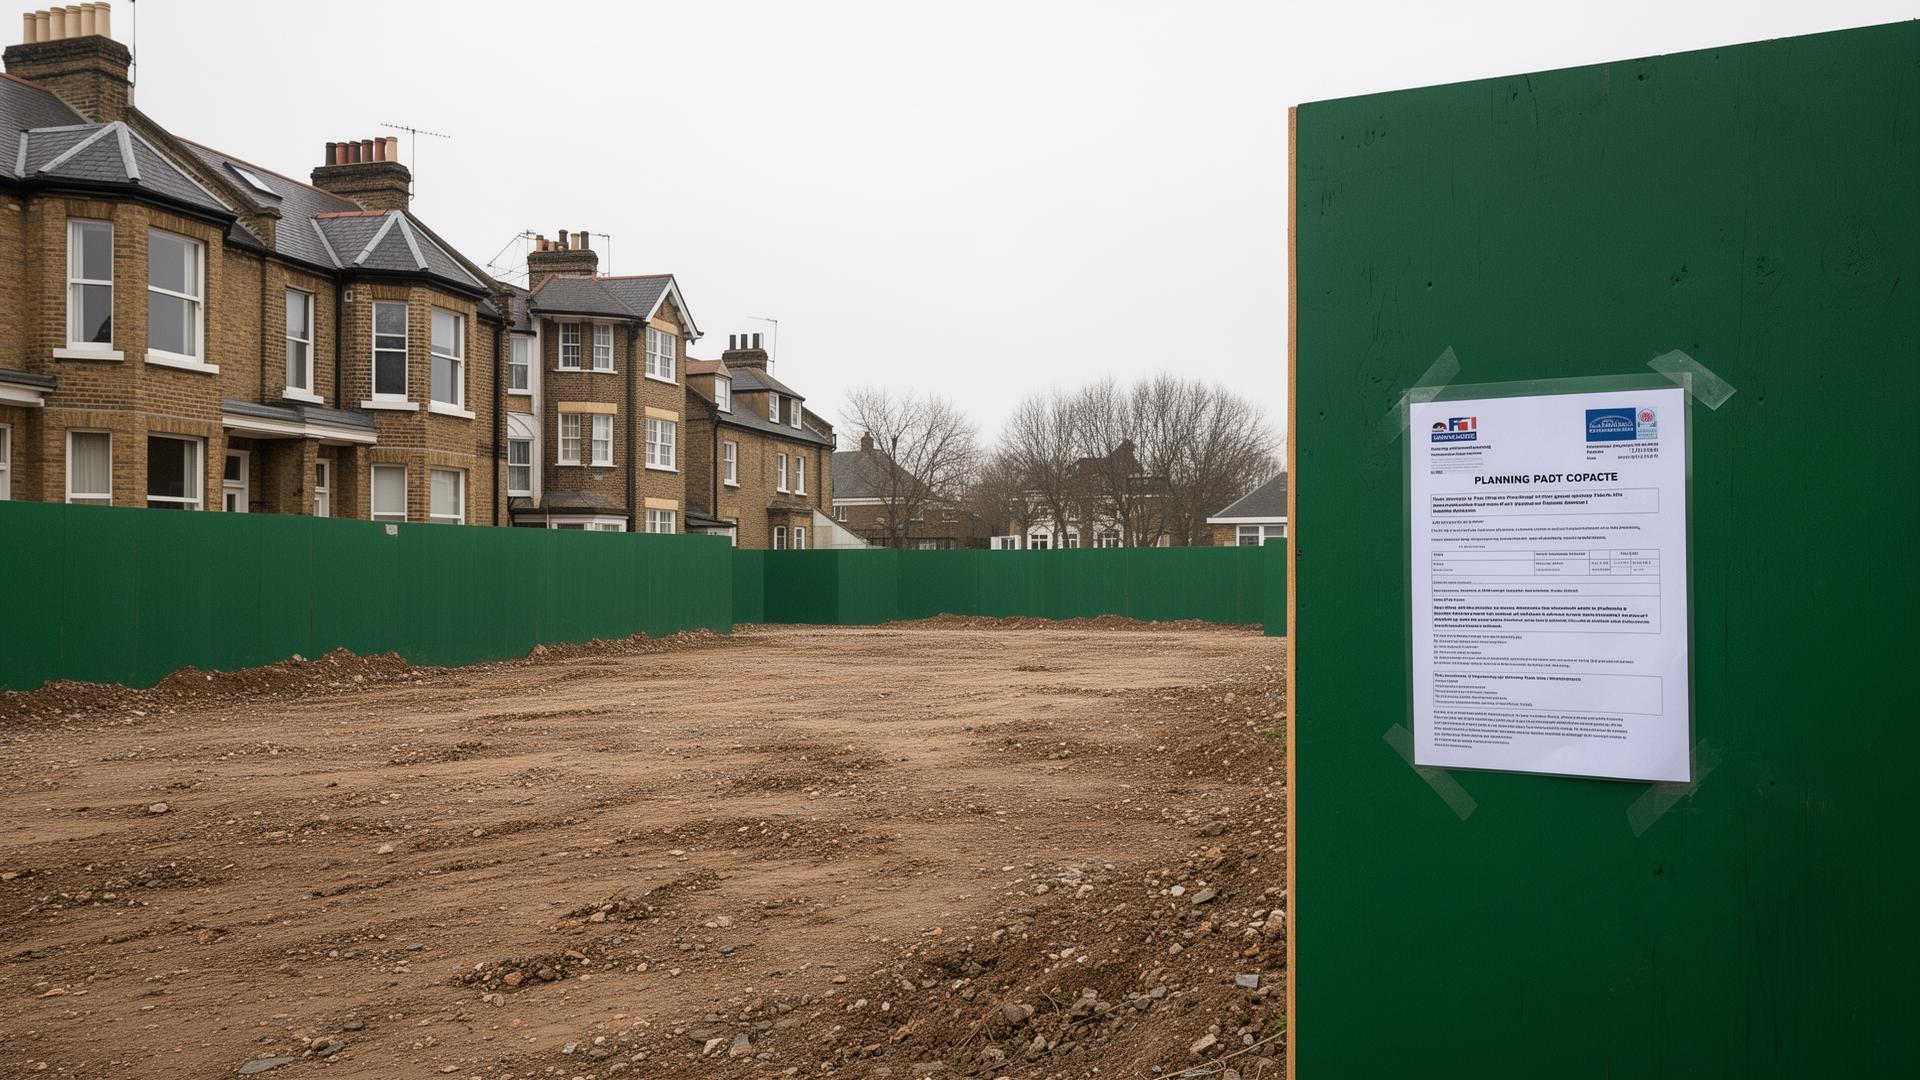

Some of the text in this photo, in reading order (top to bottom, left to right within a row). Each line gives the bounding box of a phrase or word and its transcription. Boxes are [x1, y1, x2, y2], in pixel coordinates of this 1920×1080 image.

[1474, 472, 1618, 485] PLANNING PADT COPACTE
